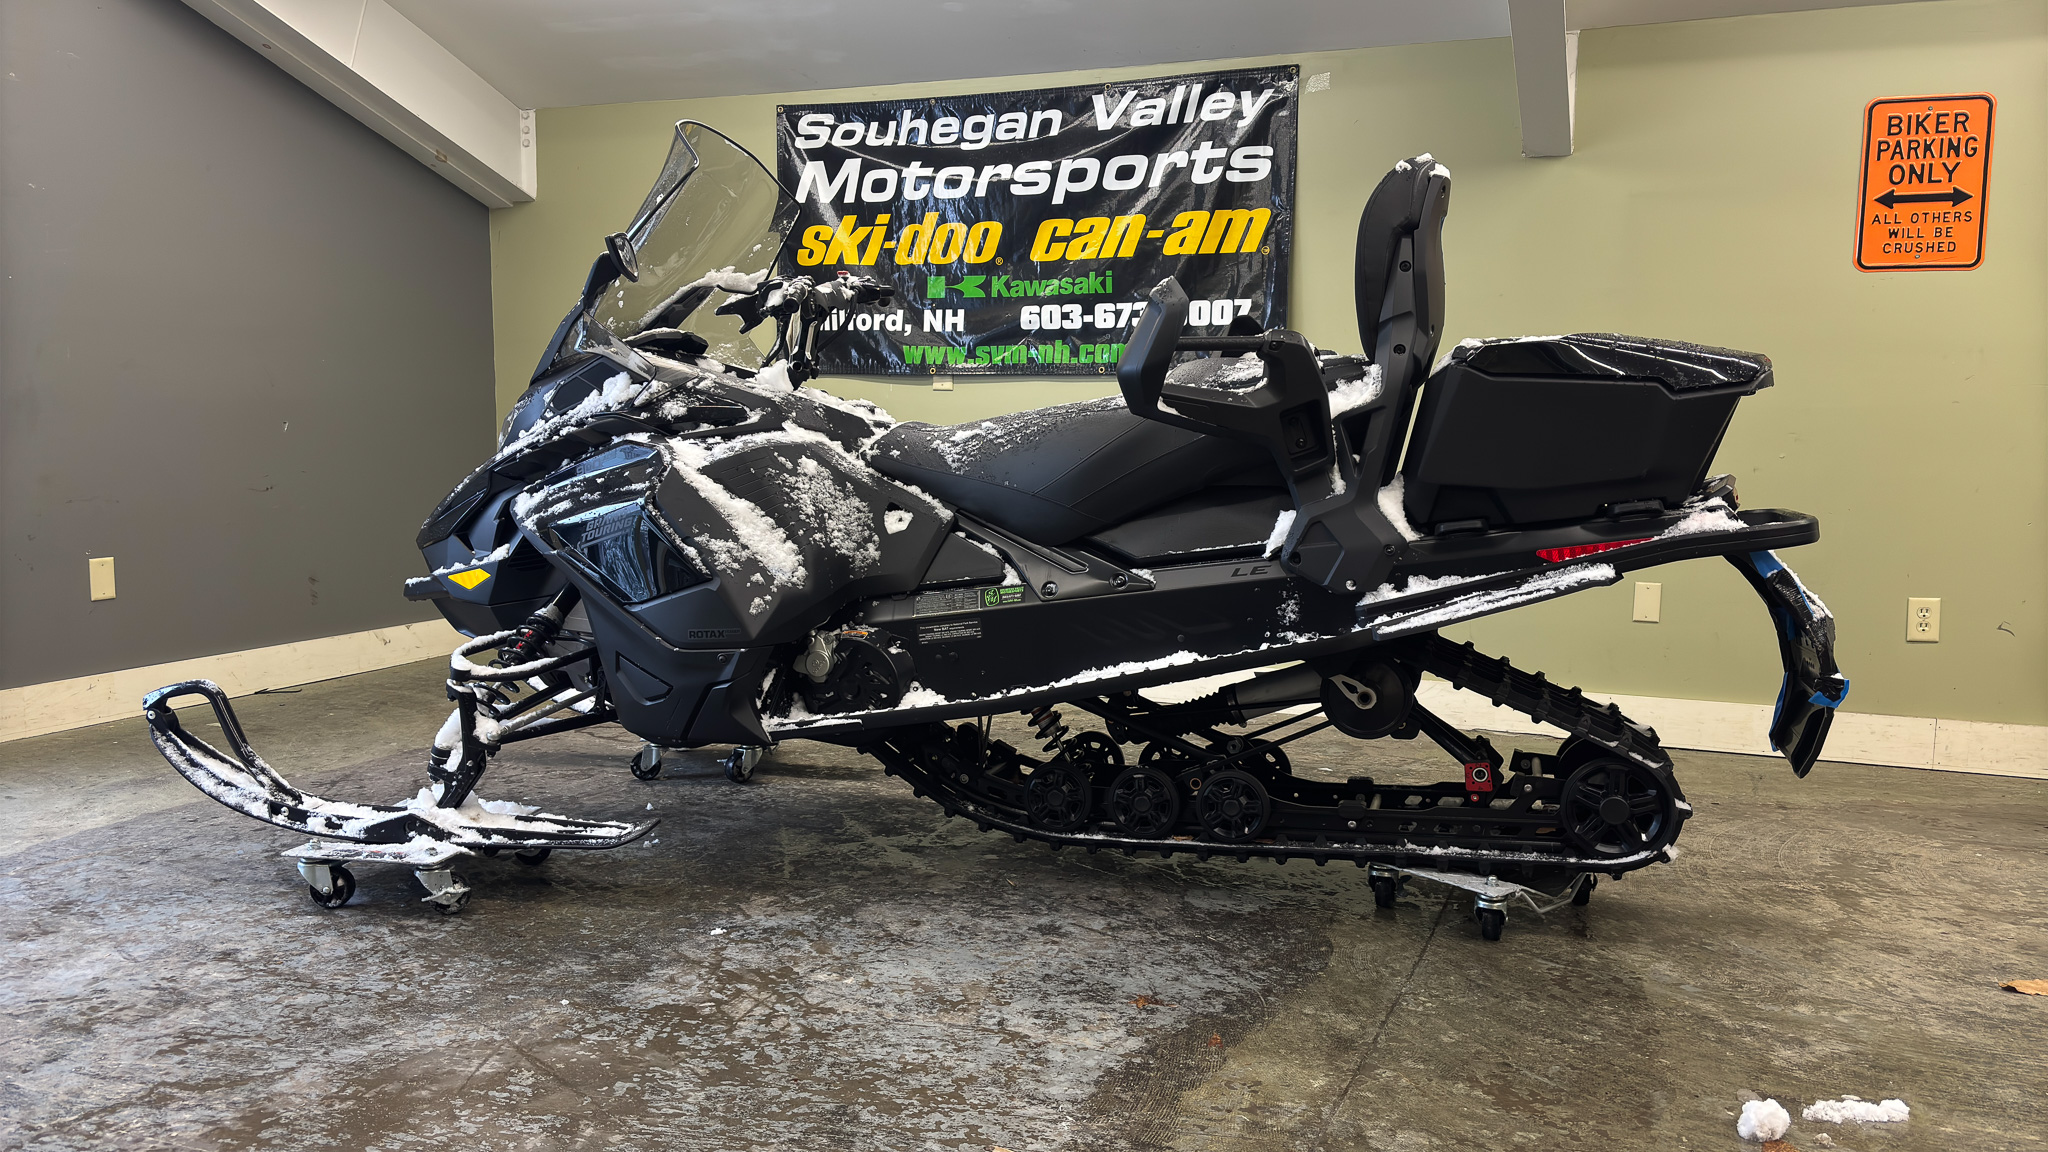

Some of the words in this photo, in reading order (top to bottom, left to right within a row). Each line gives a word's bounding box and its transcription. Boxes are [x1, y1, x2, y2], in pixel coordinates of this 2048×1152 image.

[795, 107, 1062, 151] Souhegan
[1092, 83, 1275, 132] Valley
[1887, 112, 1970, 136] BIKER
[1876, 135, 1979, 161] PARKING
[795, 138, 1274, 204] Motorsports
[1889, 161, 1961, 185] ONLY
[1871, 213, 1902, 225] ALL
[1910, 211, 1973, 224] OTHERS
[797, 211, 1003, 266] ski-doo
[1030, 207, 1271, 262] can-am
[1889, 227, 1925, 239] WILL
[1934, 226, 1953, 238] BE
[1882, 241, 1957, 254] CRUSHED
[991, 271, 1113, 297] Kawasaki
[819, 308, 912, 336] ilord,
[923, 308, 965, 332] NH
[581, 517, 633, 542] TOURING
[586, 512, 628, 531] GRAND
[1230, 564, 1273, 578] LE
[689, 630, 726, 639] ROTAX
